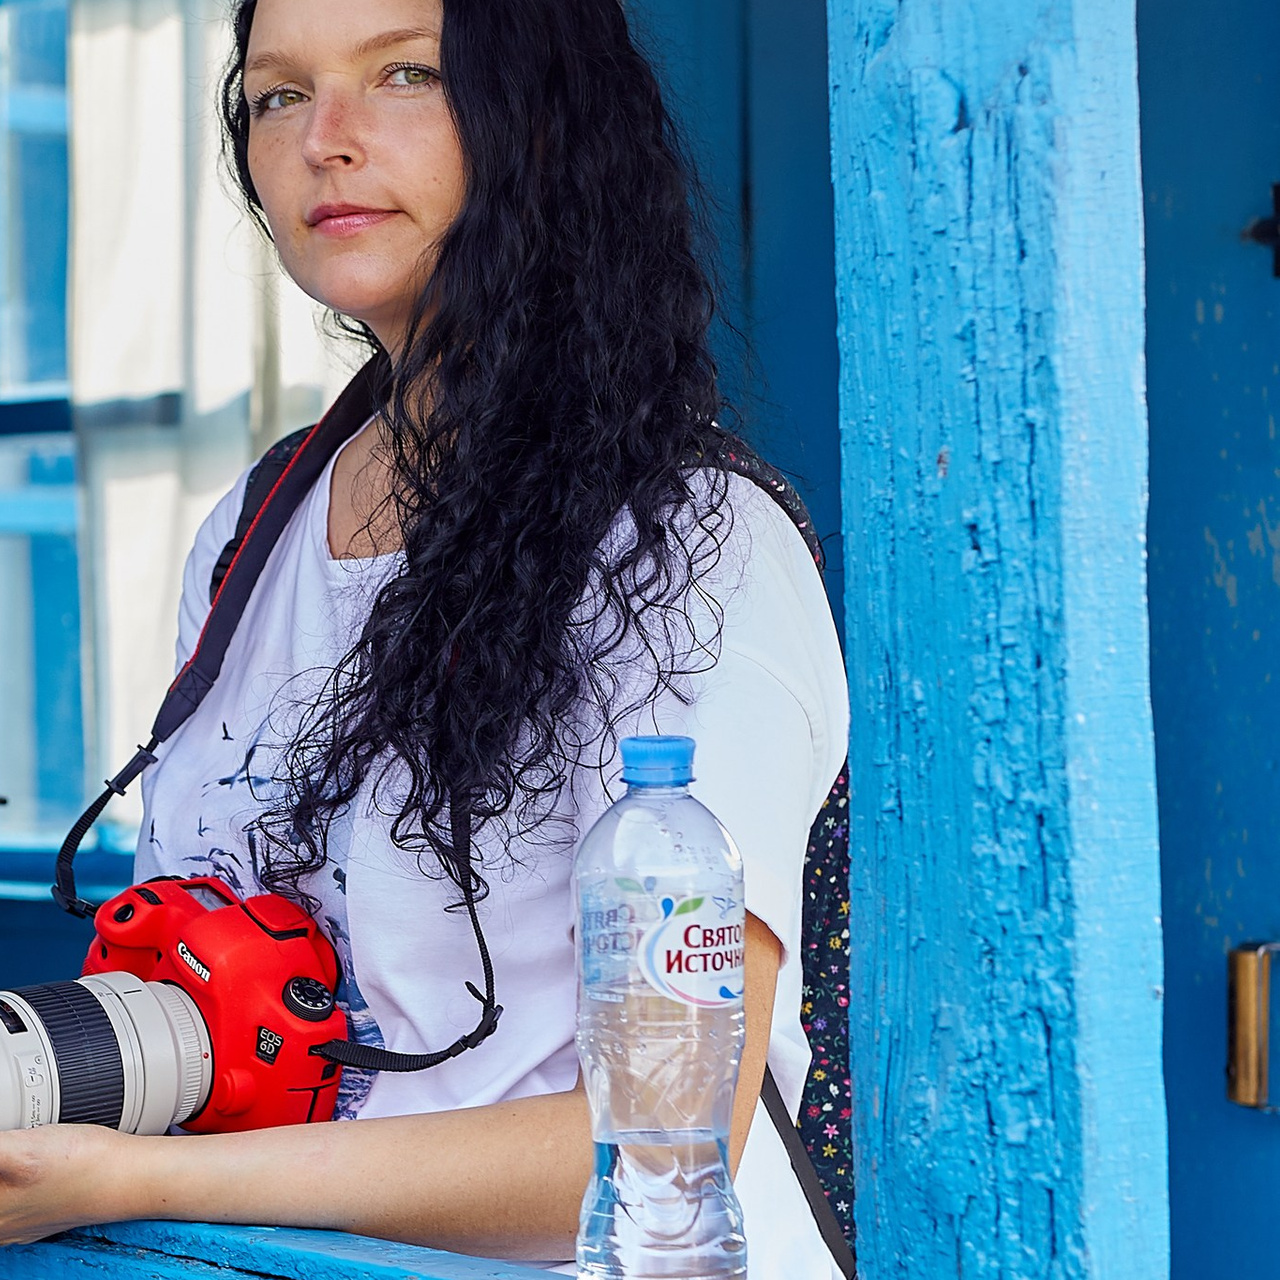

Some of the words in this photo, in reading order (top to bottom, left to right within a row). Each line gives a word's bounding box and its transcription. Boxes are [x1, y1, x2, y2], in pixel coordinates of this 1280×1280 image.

[683, 923, 743, 949] Свято
[178, 942, 211, 982] Canon
[666, 948, 744, 973] Источн
[260, 1028, 282, 1046] EOS
[260, 1041, 275, 1055] 6D
